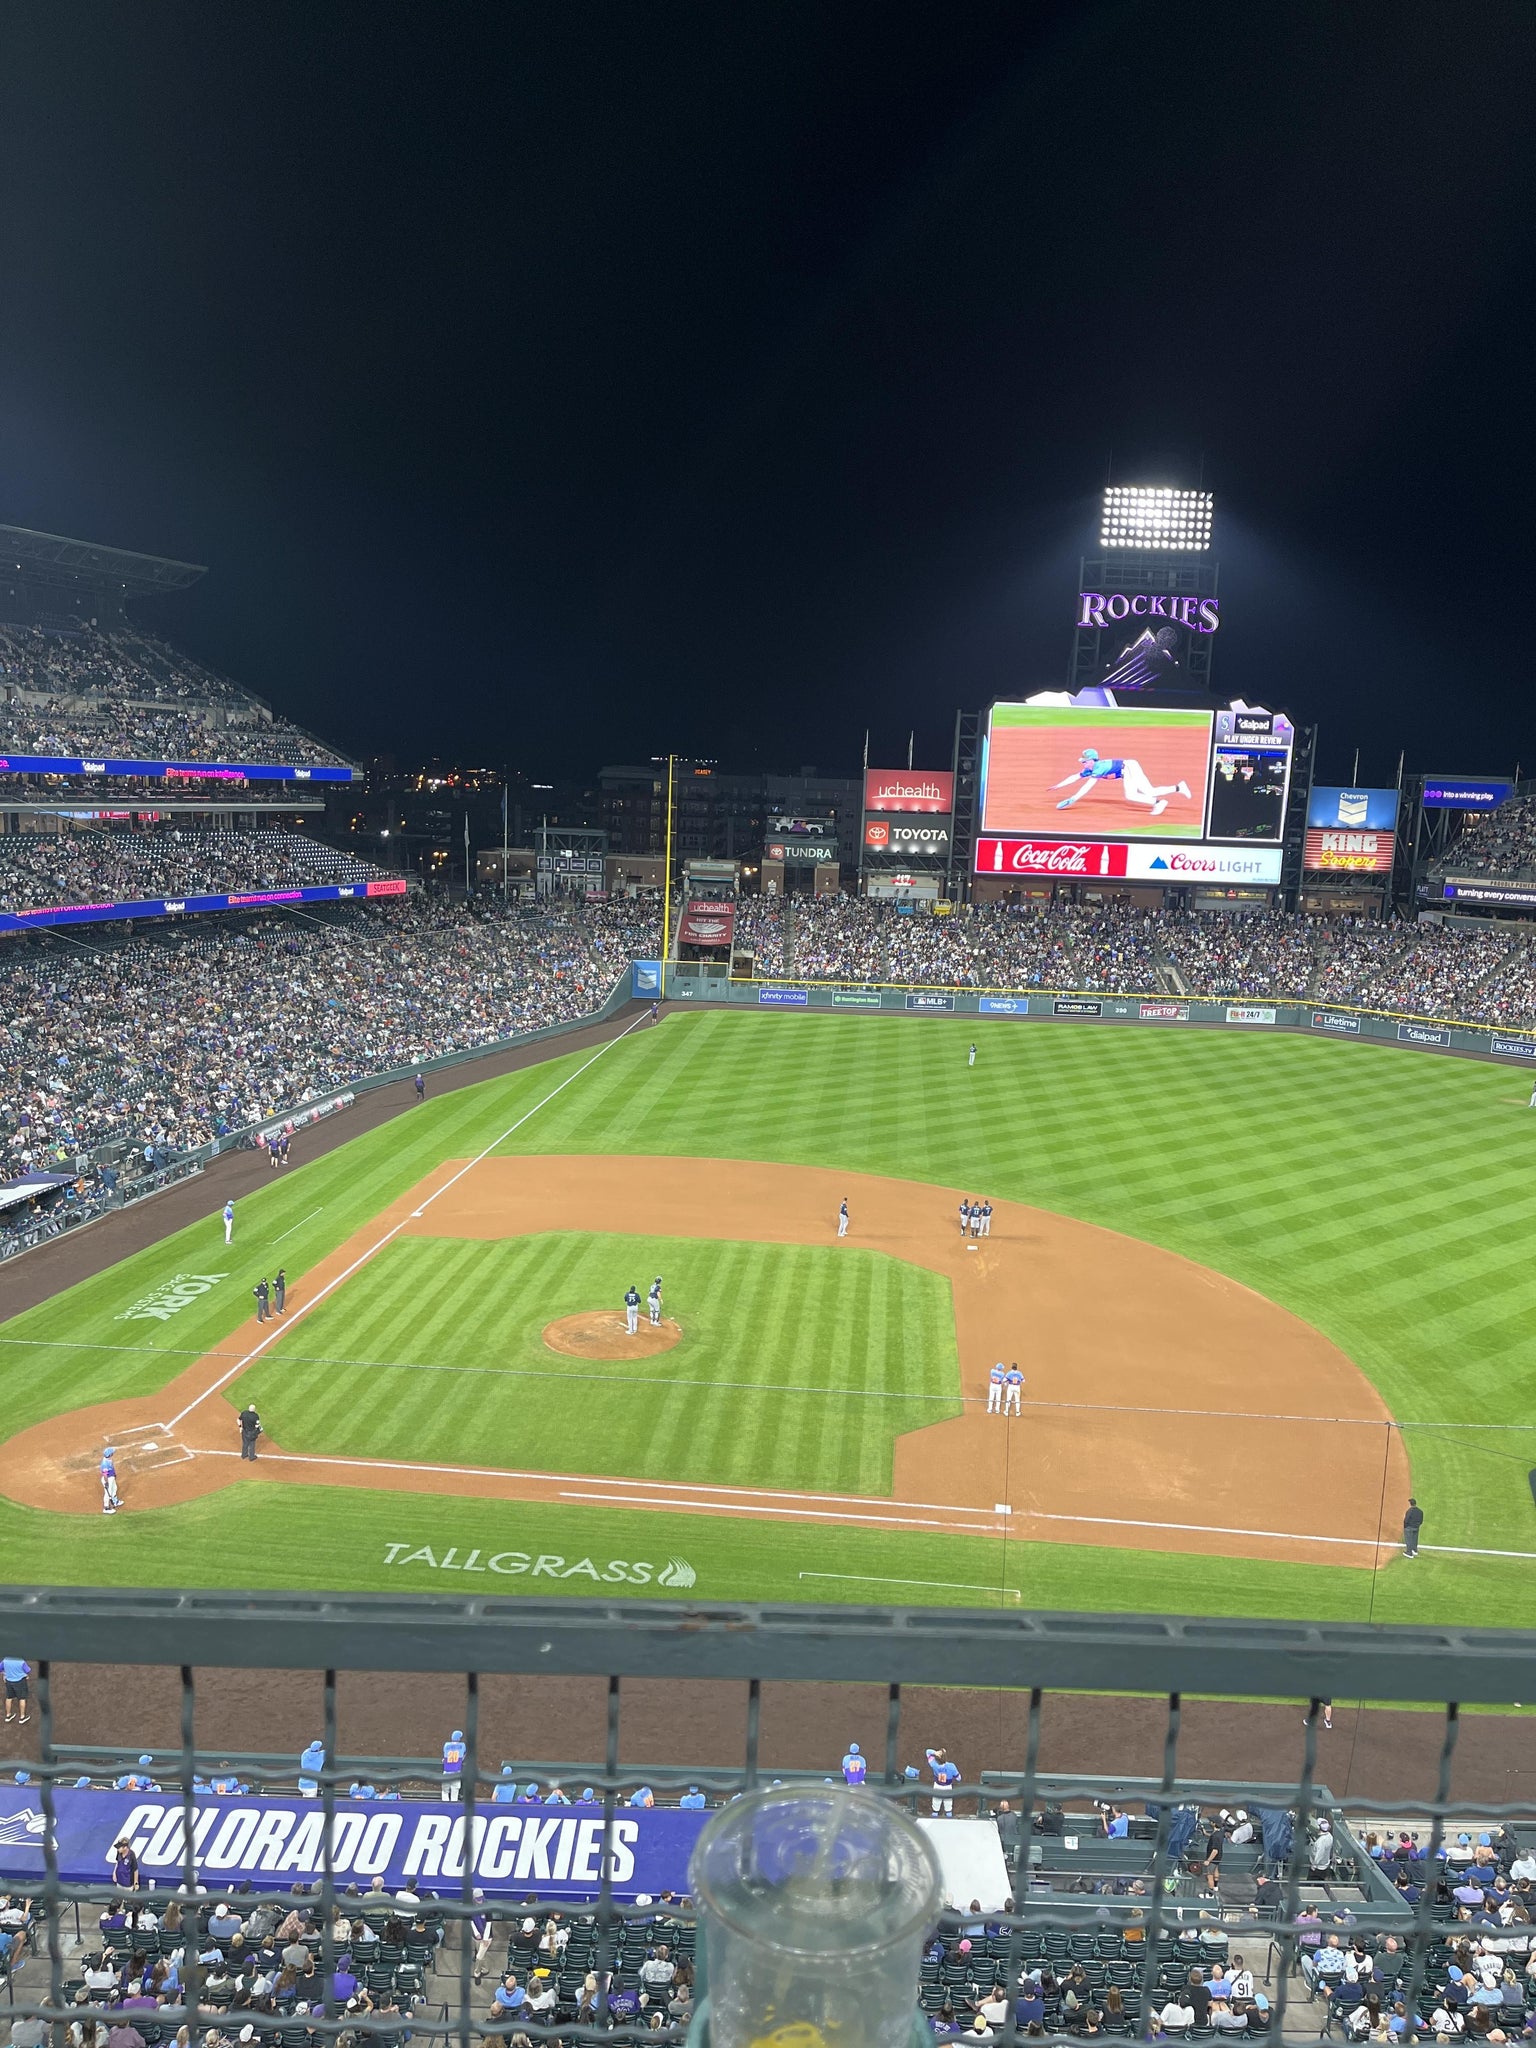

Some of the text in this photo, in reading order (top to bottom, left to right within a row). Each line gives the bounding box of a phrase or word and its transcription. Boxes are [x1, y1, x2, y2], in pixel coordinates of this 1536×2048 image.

[1078, 593, 1219, 633] ROCKIES
[1240, 720, 1270, 731] dialpad
[1224, 735, 1283, 745] PLAY UNDER REVIEW
[83, 762, 105, 773] dialpad
[879, 782, 941, 799] uchealth
[1340, 793, 1368, 801] Chevron
[893, 828, 948, 841] TOYOTA
[1321, 834, 1378, 853] KING
[785, 847, 832, 859] TUNDRA
[1320, 850, 1377, 868] Soopers
[1170, 853, 1262, 873] Coors LIGHT
[1457, 888, 1484, 899] turning
[1484, 891, 1504, 900] every
[165, 902, 186, 911] dialpad
[694, 902, 730, 912] uchealth
[761, 992, 805, 1001] xfinity mobile
[926, 998, 947, 1006] MLB+
[1246, 1010, 1261, 1018] 24/7
[1324, 1015, 1357, 1028] Lifetime
[1409, 1030, 1441, 1042] dialpad
[131, 1273, 231, 1320] YORK
[383, 1543, 654, 1585] TALLGRASS
[105, 1804, 639, 1883] COLORADO ROCKIES
[1237, 1982, 1249, 1996] 91
